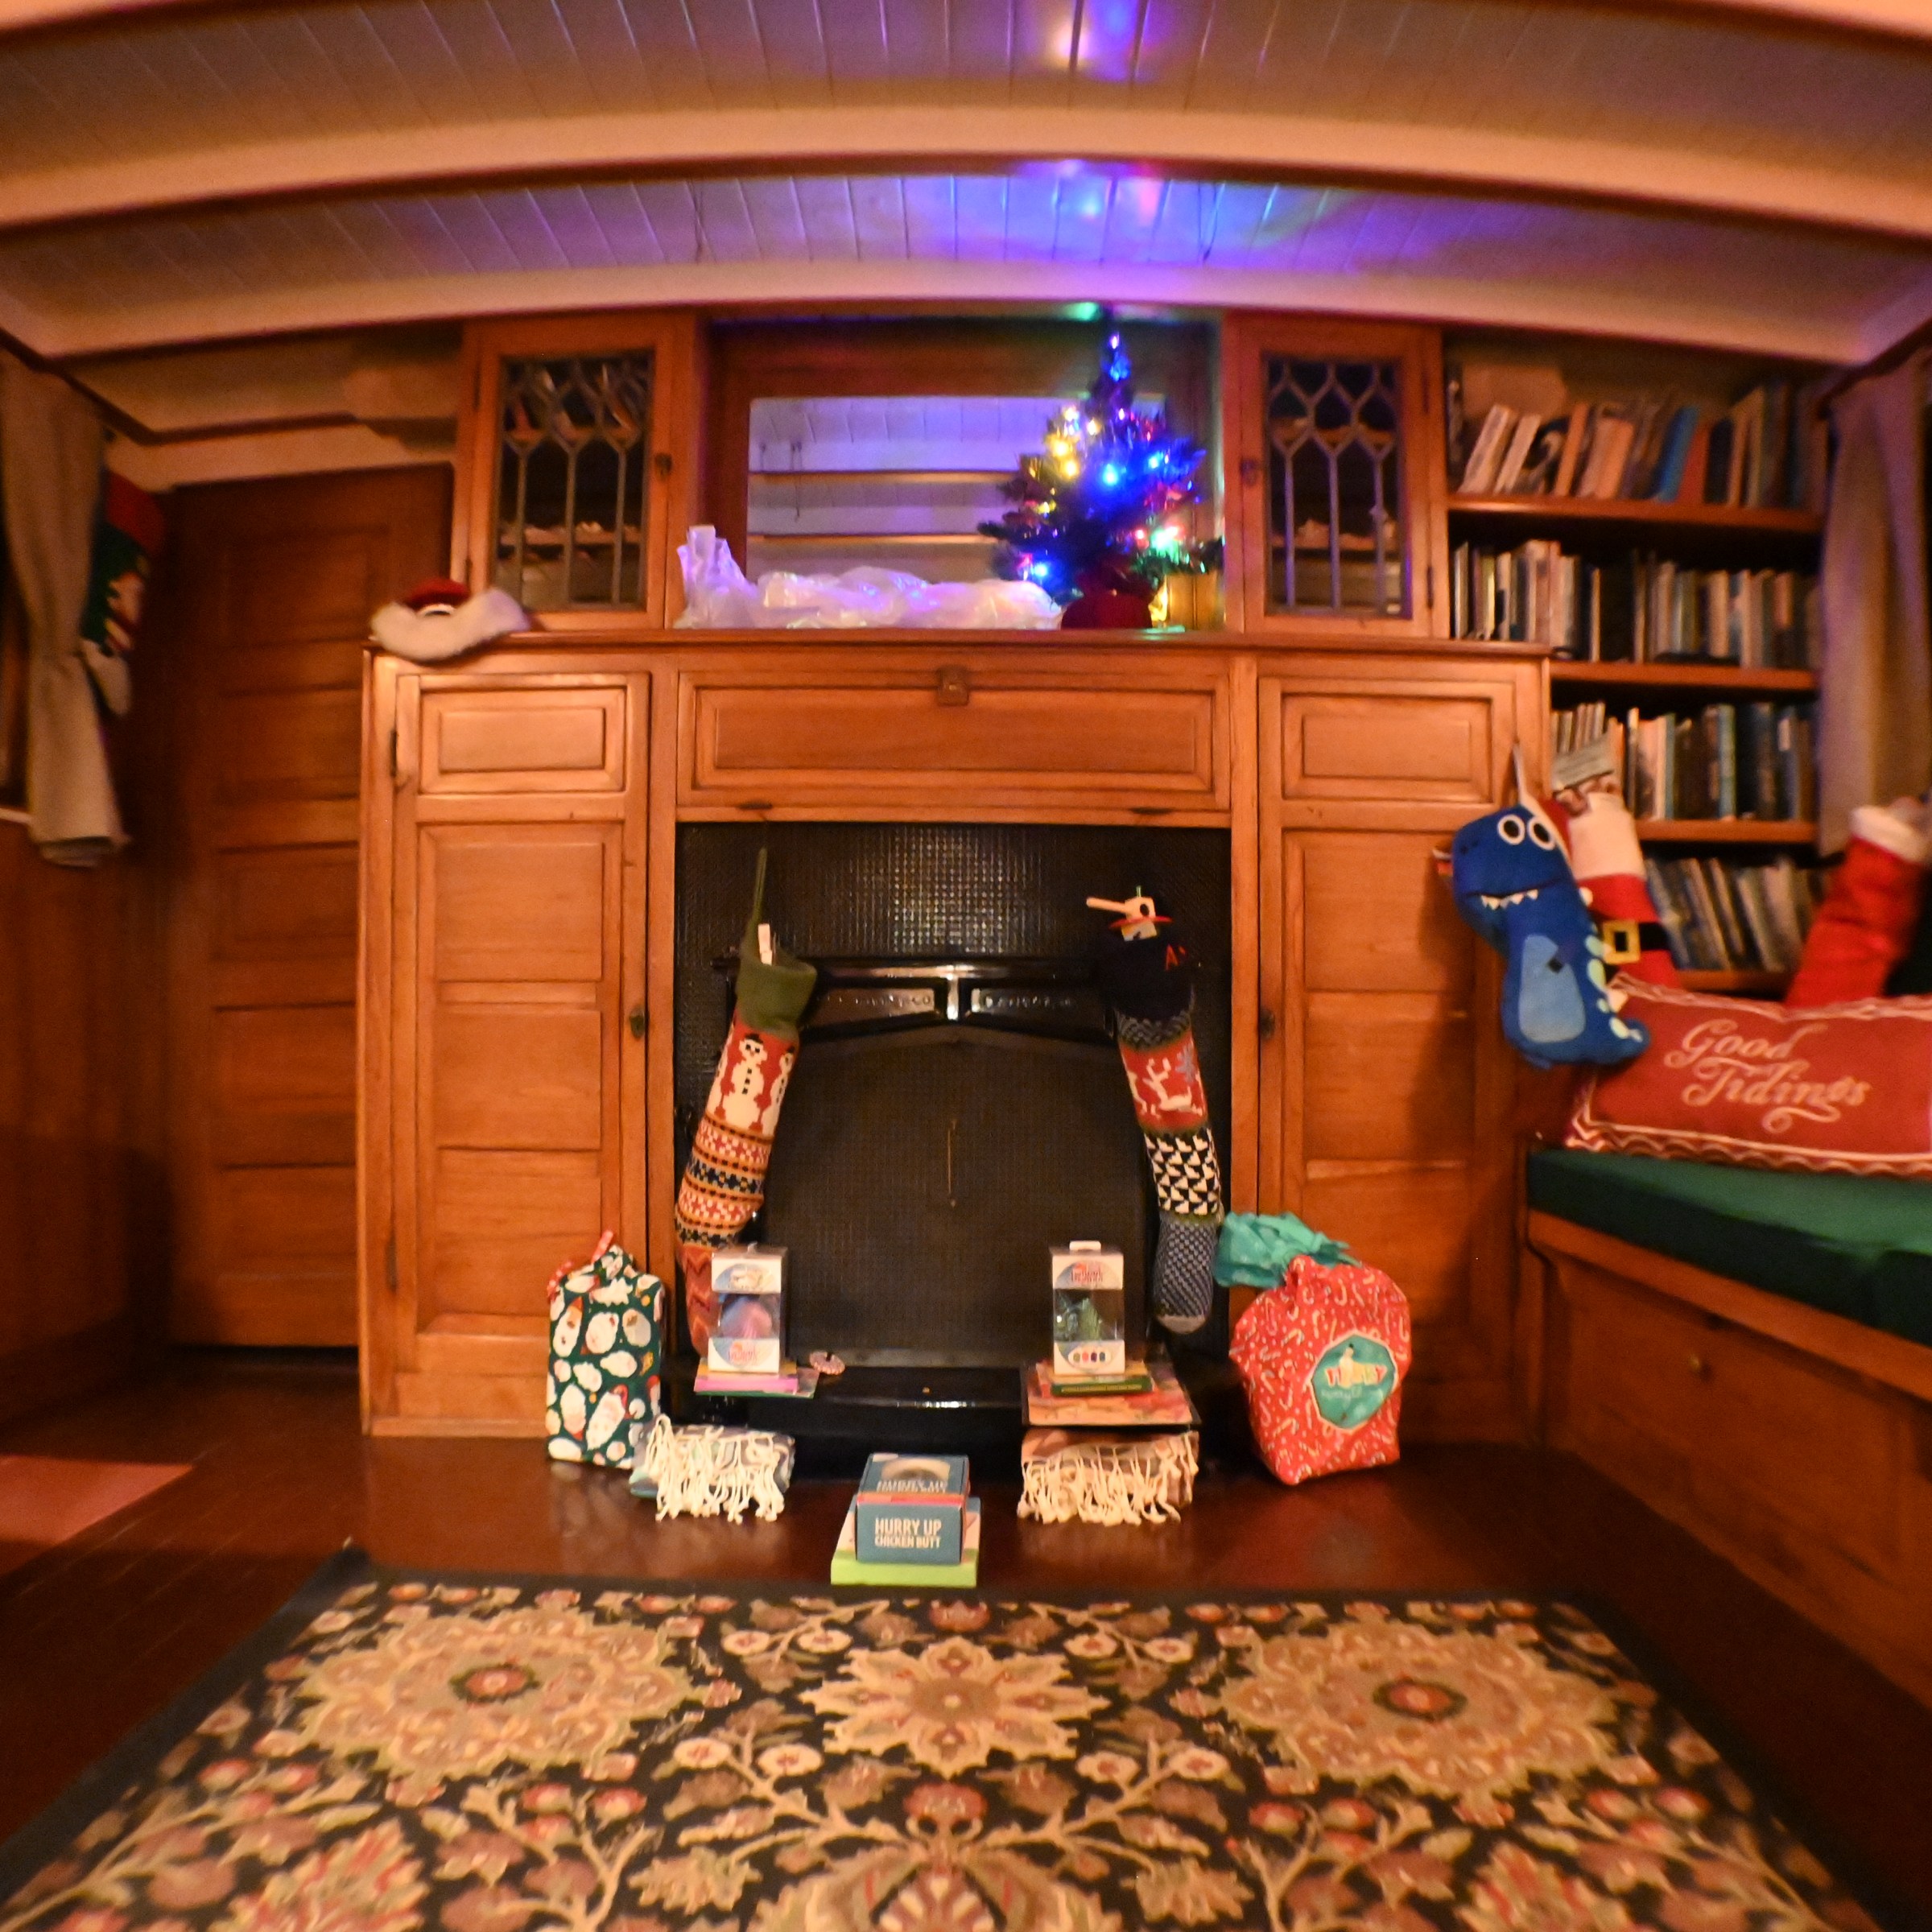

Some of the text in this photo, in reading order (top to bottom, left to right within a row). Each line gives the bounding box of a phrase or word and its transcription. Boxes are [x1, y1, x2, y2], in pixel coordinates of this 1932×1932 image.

[1664, 1018, 1829, 1069] Good
[1682, 1056, 1872, 1133] Tidings
[874, 1517, 942, 1536] HURRY UP
[874, 1535, 941, 1549] CHICKEN BUTT
